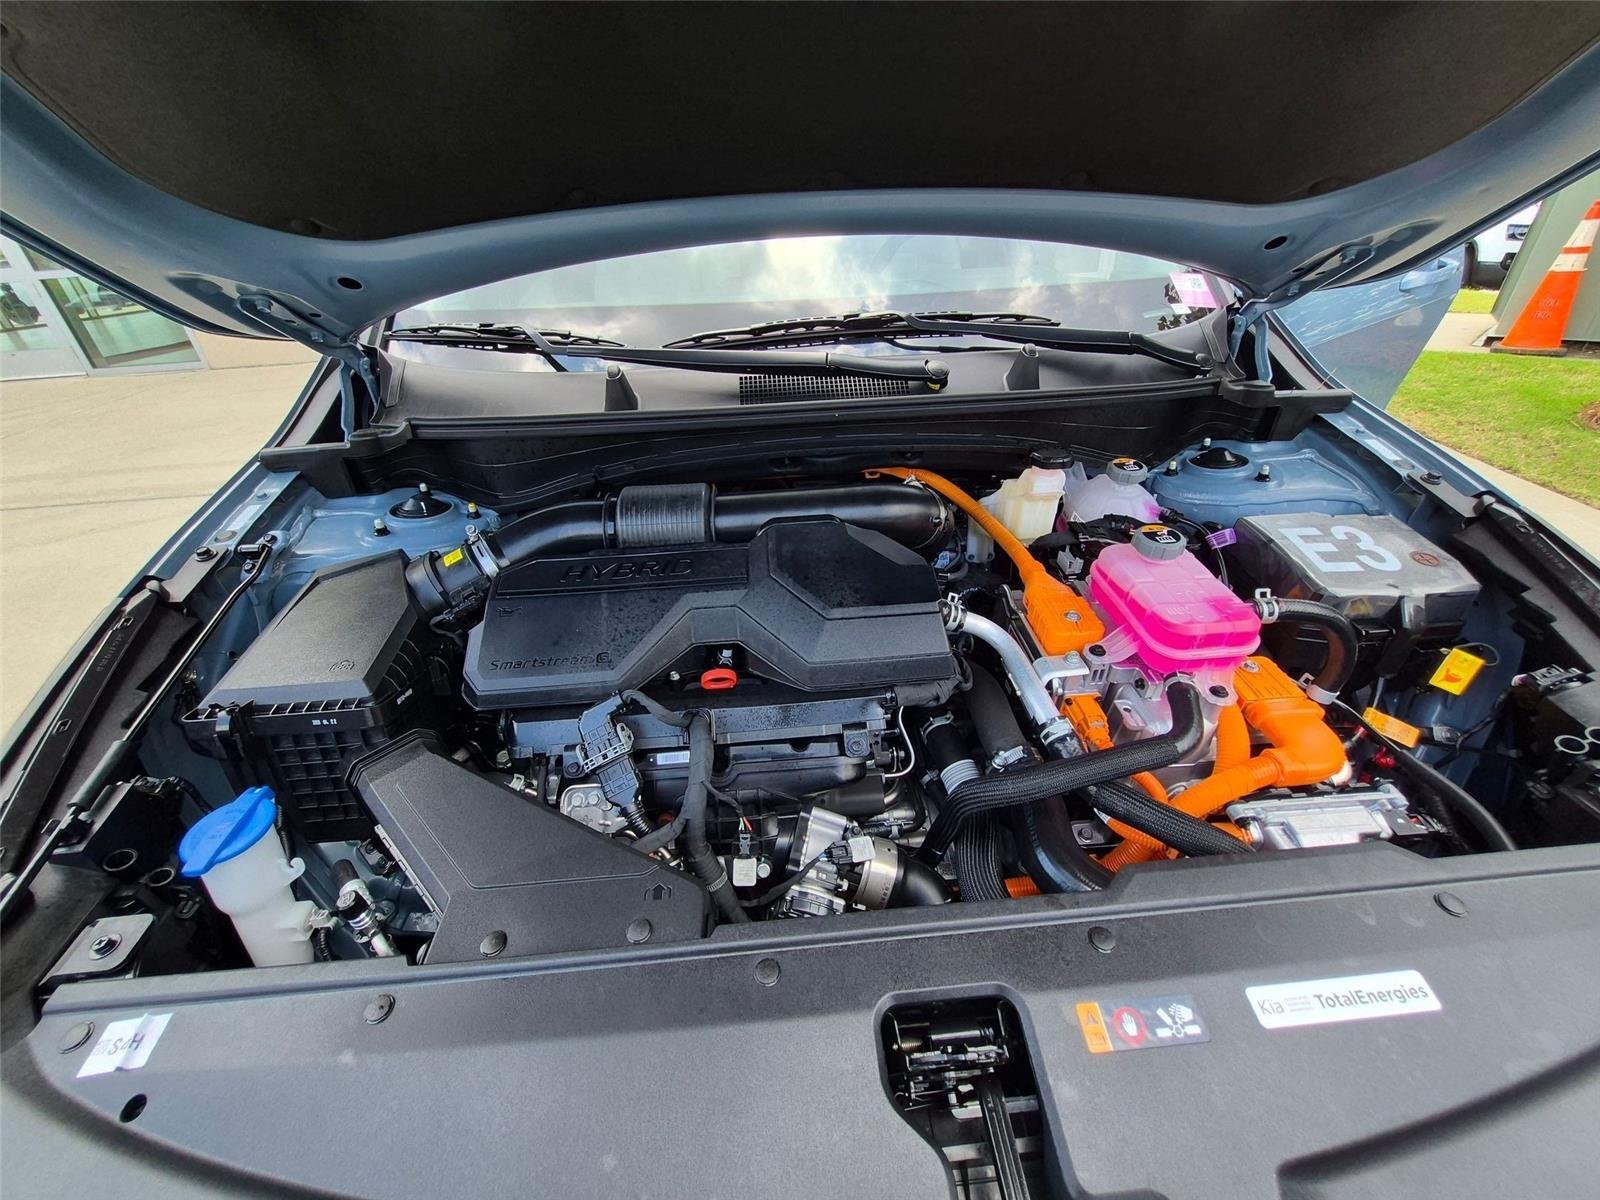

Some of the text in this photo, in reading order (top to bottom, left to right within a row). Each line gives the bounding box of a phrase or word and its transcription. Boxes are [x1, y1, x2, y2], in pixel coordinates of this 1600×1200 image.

[1278, 525, 1402, 572] E3
[559, 558, 693, 583] HYBRID
[1256, 998, 1285, 1016] Kia
[1312, 984, 1430, 1010] TotalEnergies
